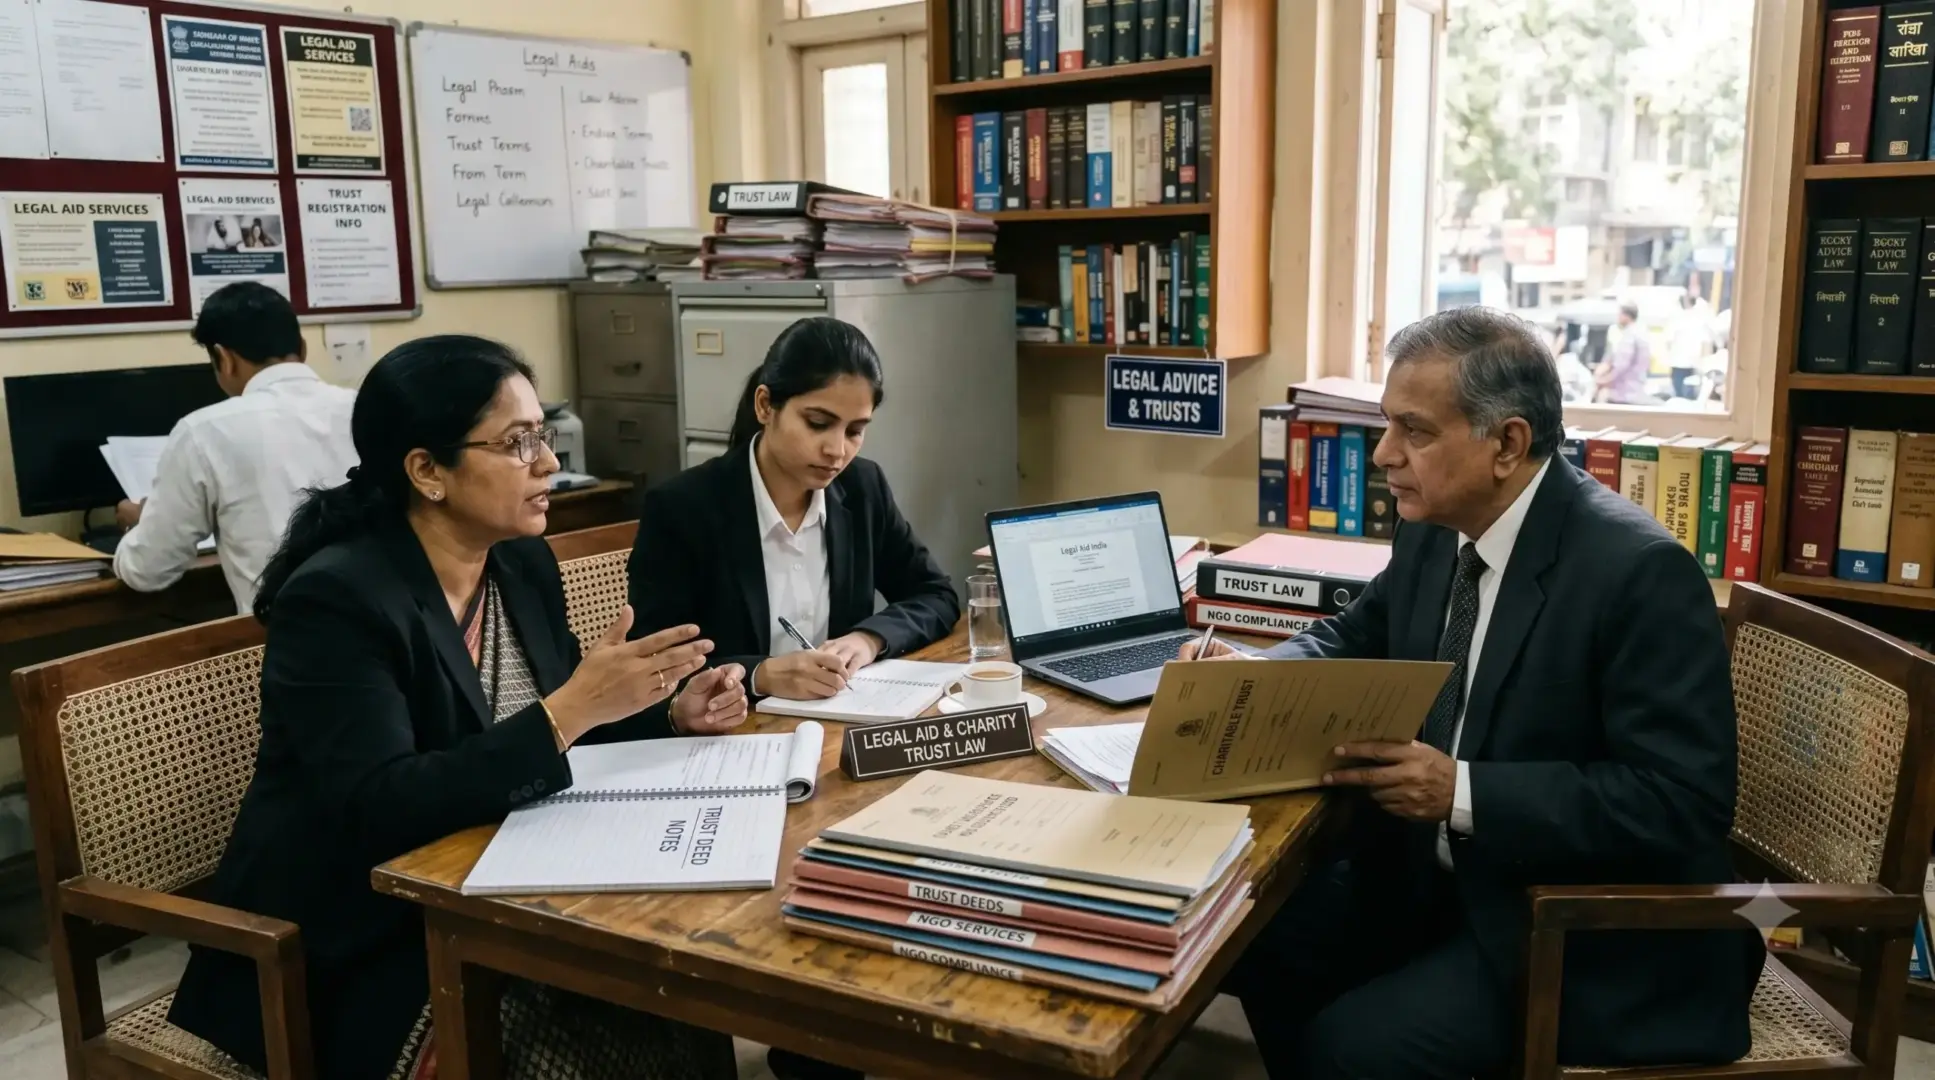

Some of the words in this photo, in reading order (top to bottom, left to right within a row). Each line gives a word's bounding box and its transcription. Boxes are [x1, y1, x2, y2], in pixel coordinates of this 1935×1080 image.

[300, 35, 336, 49] LEGAL
[338, 39, 357, 51] AID
[1841, 47, 1859, 55] AND
[304, 49, 356, 63] SERVICES
[523, 47, 559, 77] Legal
[442, 75, 477, 104] Legal
[447, 135, 483, 151] Trust
[452, 163, 485, 180] From
[186, 195, 215, 204] LEGAL
[217, 196, 233, 204] AID
[235, 196, 276, 205] SERVICES
[328, 188, 363, 199] TRUST
[733, 190, 765, 203] TRUST
[768, 190, 793, 202] LAW
[14, 203, 58, 214] LEGAL
[61, 204, 85, 214] AID
[89, 204, 149, 215] SERVICES
[307, 204, 387, 214] REGISTRATION
[456, 191, 490, 218] Legal
[335, 218, 362, 229] INFO
[1816, 247, 1853, 257] ADVICE
[1869, 249, 1907, 259] ADVICE
[1823, 259, 1845, 268] LAW
[1876, 261, 1899, 271] LAW
[1826, 313, 1832, 322] 1
[1877, 316, 1885, 326] 2
[1113, 368, 1160, 392] LEGAL
[1162, 371, 1218, 396] ADVICE
[1128, 398, 1140, 419] &
[1142, 399, 1201, 423] TRUSTS
[1060, 544, 1079, 556] Legal
[1080, 543, 1091, 552] Aid
[1091, 541, 1108, 550] India
[1222, 577, 1269, 594] TRUST
[1272, 582, 1305, 599] LAW
[1207, 610, 1231, 622] NGO
[1234, 613, 1309, 631] COMPLIANCE
[863, 728, 913, 750] LEGAL
[915, 724, 940, 743] AID
[943, 722, 955, 738] &
[956, 712, 1018, 736] CHARITY
[1211, 708, 1243, 776] CHARITABLE
[1233, 679, 1255, 712] TRUST
[904, 744, 951, 764] TRUST
[955, 737, 987, 757] LAW
[703, 804, 724, 836] TRUST
[658, 819, 688, 853] NOTES
[690, 837, 715, 866] DEED
[914, 885, 957, 904] TRUST
[960, 894, 1004, 914] DEEDS
[917, 914, 952, 928] NGO
[954, 921, 1026, 943] SERVICES
[899, 946, 928, 961] NGO
[930, 953, 1016, 979] COMPLIANCE
